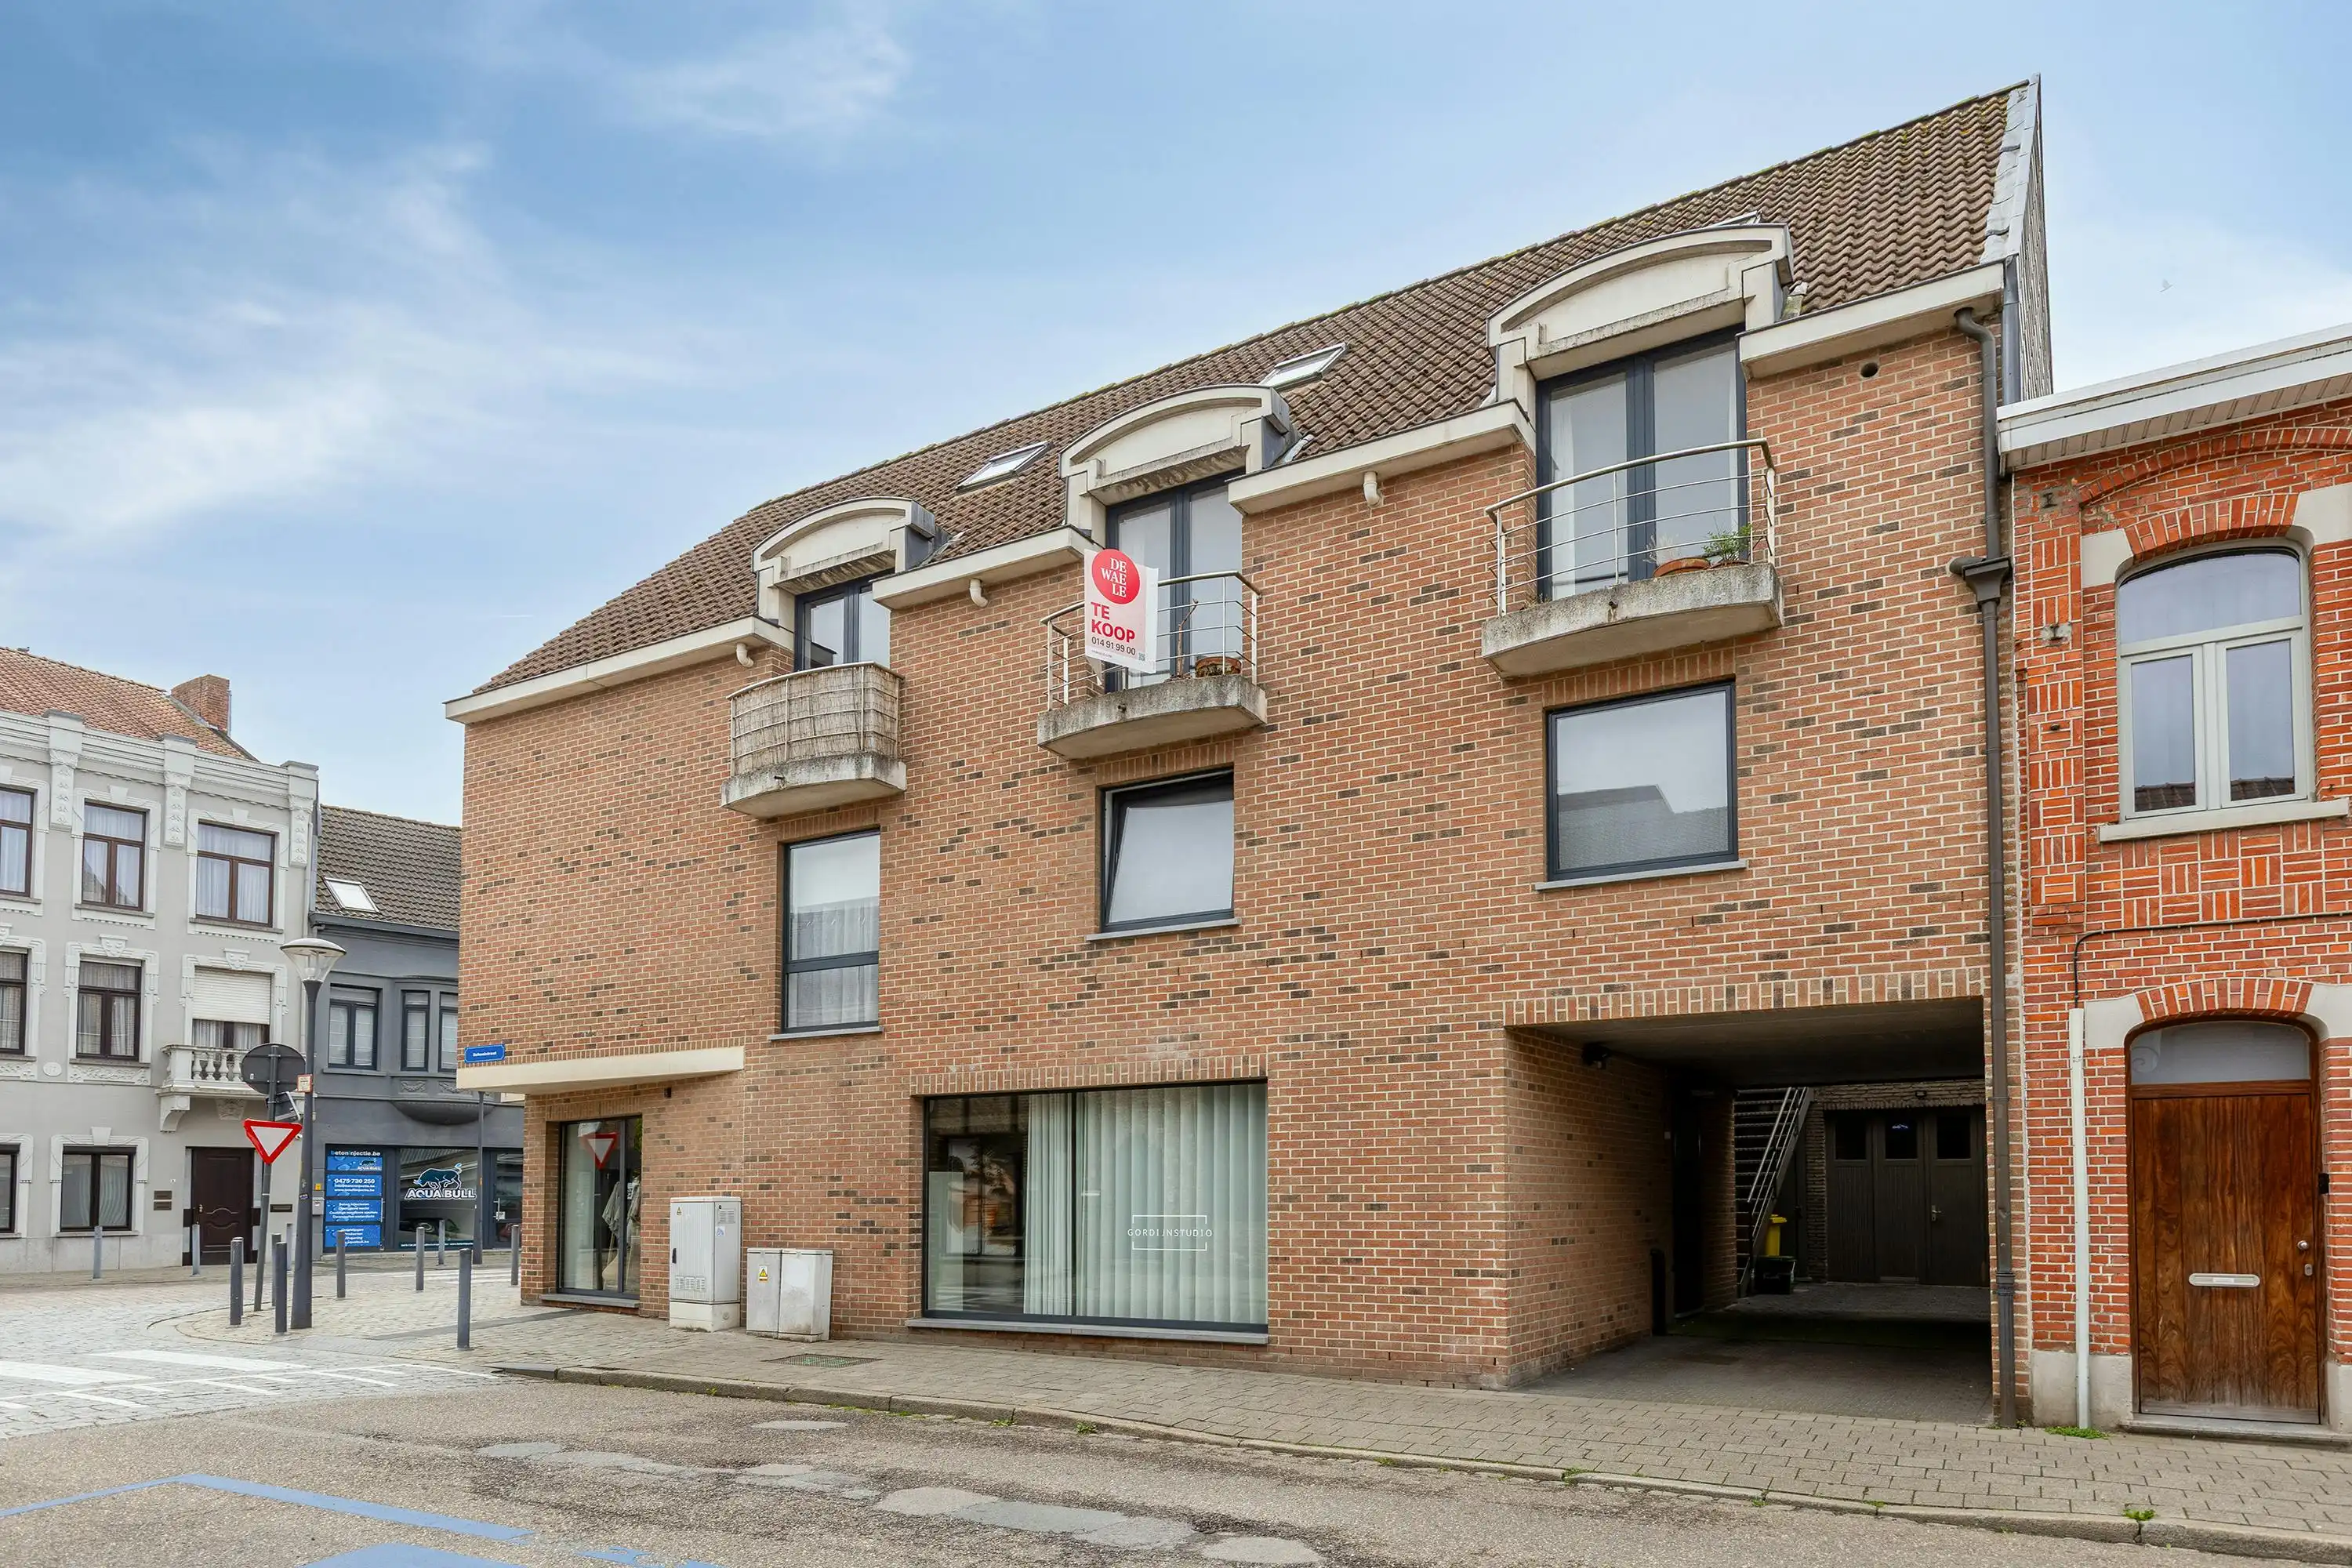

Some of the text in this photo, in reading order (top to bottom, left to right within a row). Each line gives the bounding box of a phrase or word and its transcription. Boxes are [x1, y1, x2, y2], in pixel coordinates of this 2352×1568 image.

[1110, 557, 1127, 573] DE
[1101, 567, 1127, 586] WAE
[1112, 583, 1127, 598] LE
[1091, 601, 1110, 620] TE
[1091, 619, 1135, 643] KOOP
[1091, 637, 1136, 655] 014 91 99 00
[407, 1189, 476, 1199] AQUA BULL
[1127, 1229, 1213, 1237] GORDIJNSTUDIO
